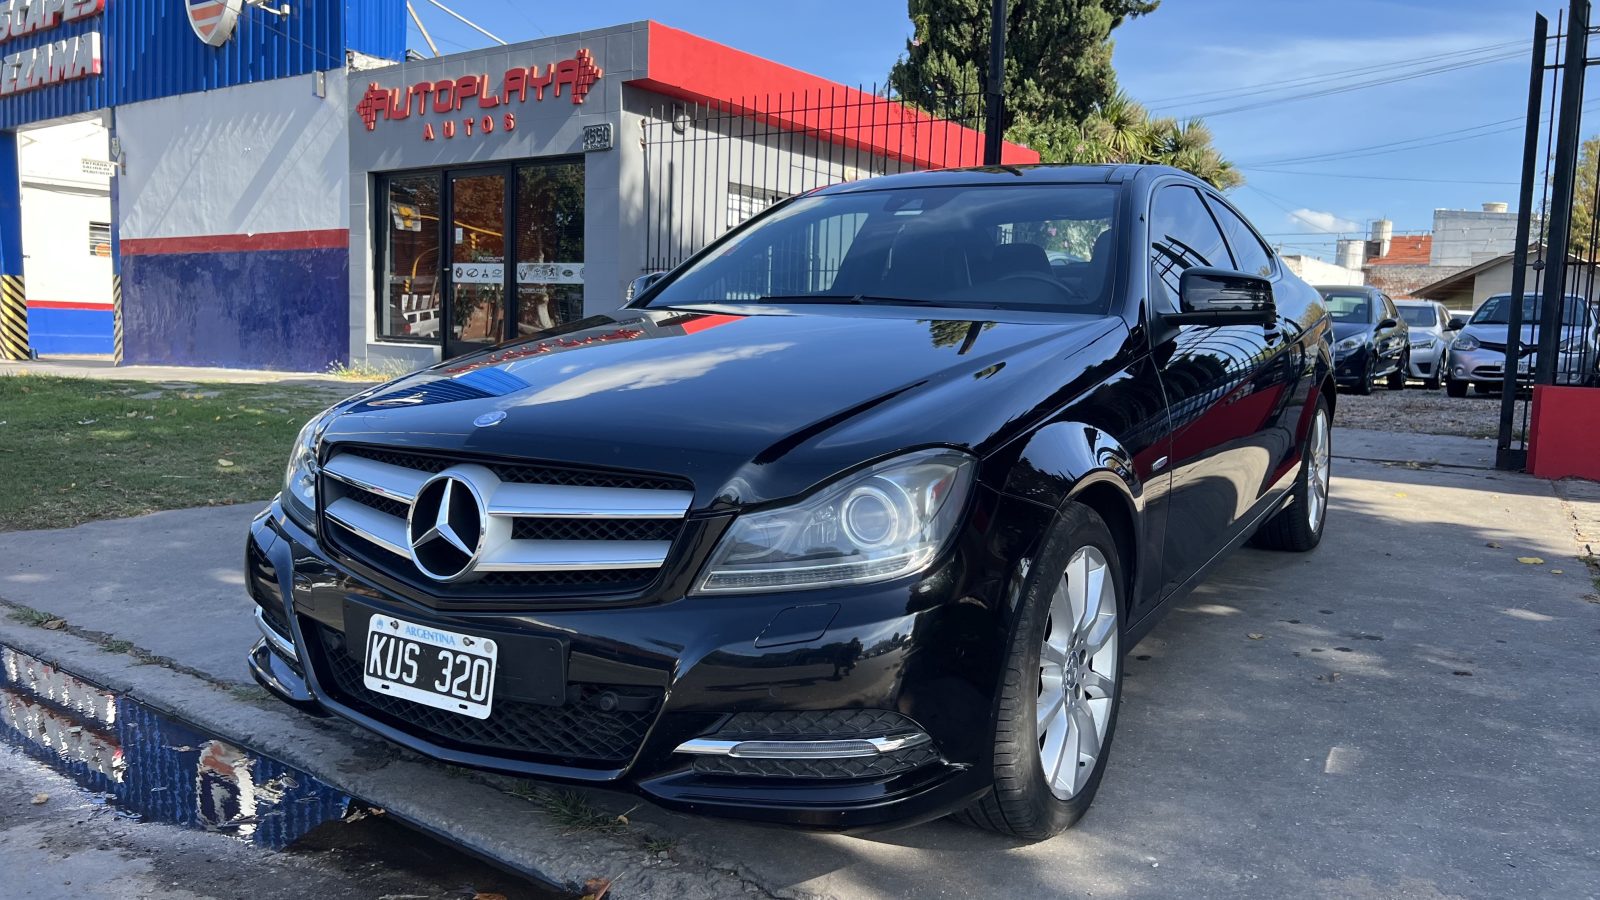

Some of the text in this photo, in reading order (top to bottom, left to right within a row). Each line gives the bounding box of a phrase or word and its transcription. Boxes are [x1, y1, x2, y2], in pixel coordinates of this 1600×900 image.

[0, 32, 99, 95] EZAMA
[371, 60, 580, 119] AUTOPLAYA
[423, 112, 516, 141] AUTOS
[584, 126, 610, 144] 4550
[405, 625, 456, 646] ARGENTINA
[369, 634, 490, 701] KUS 320
